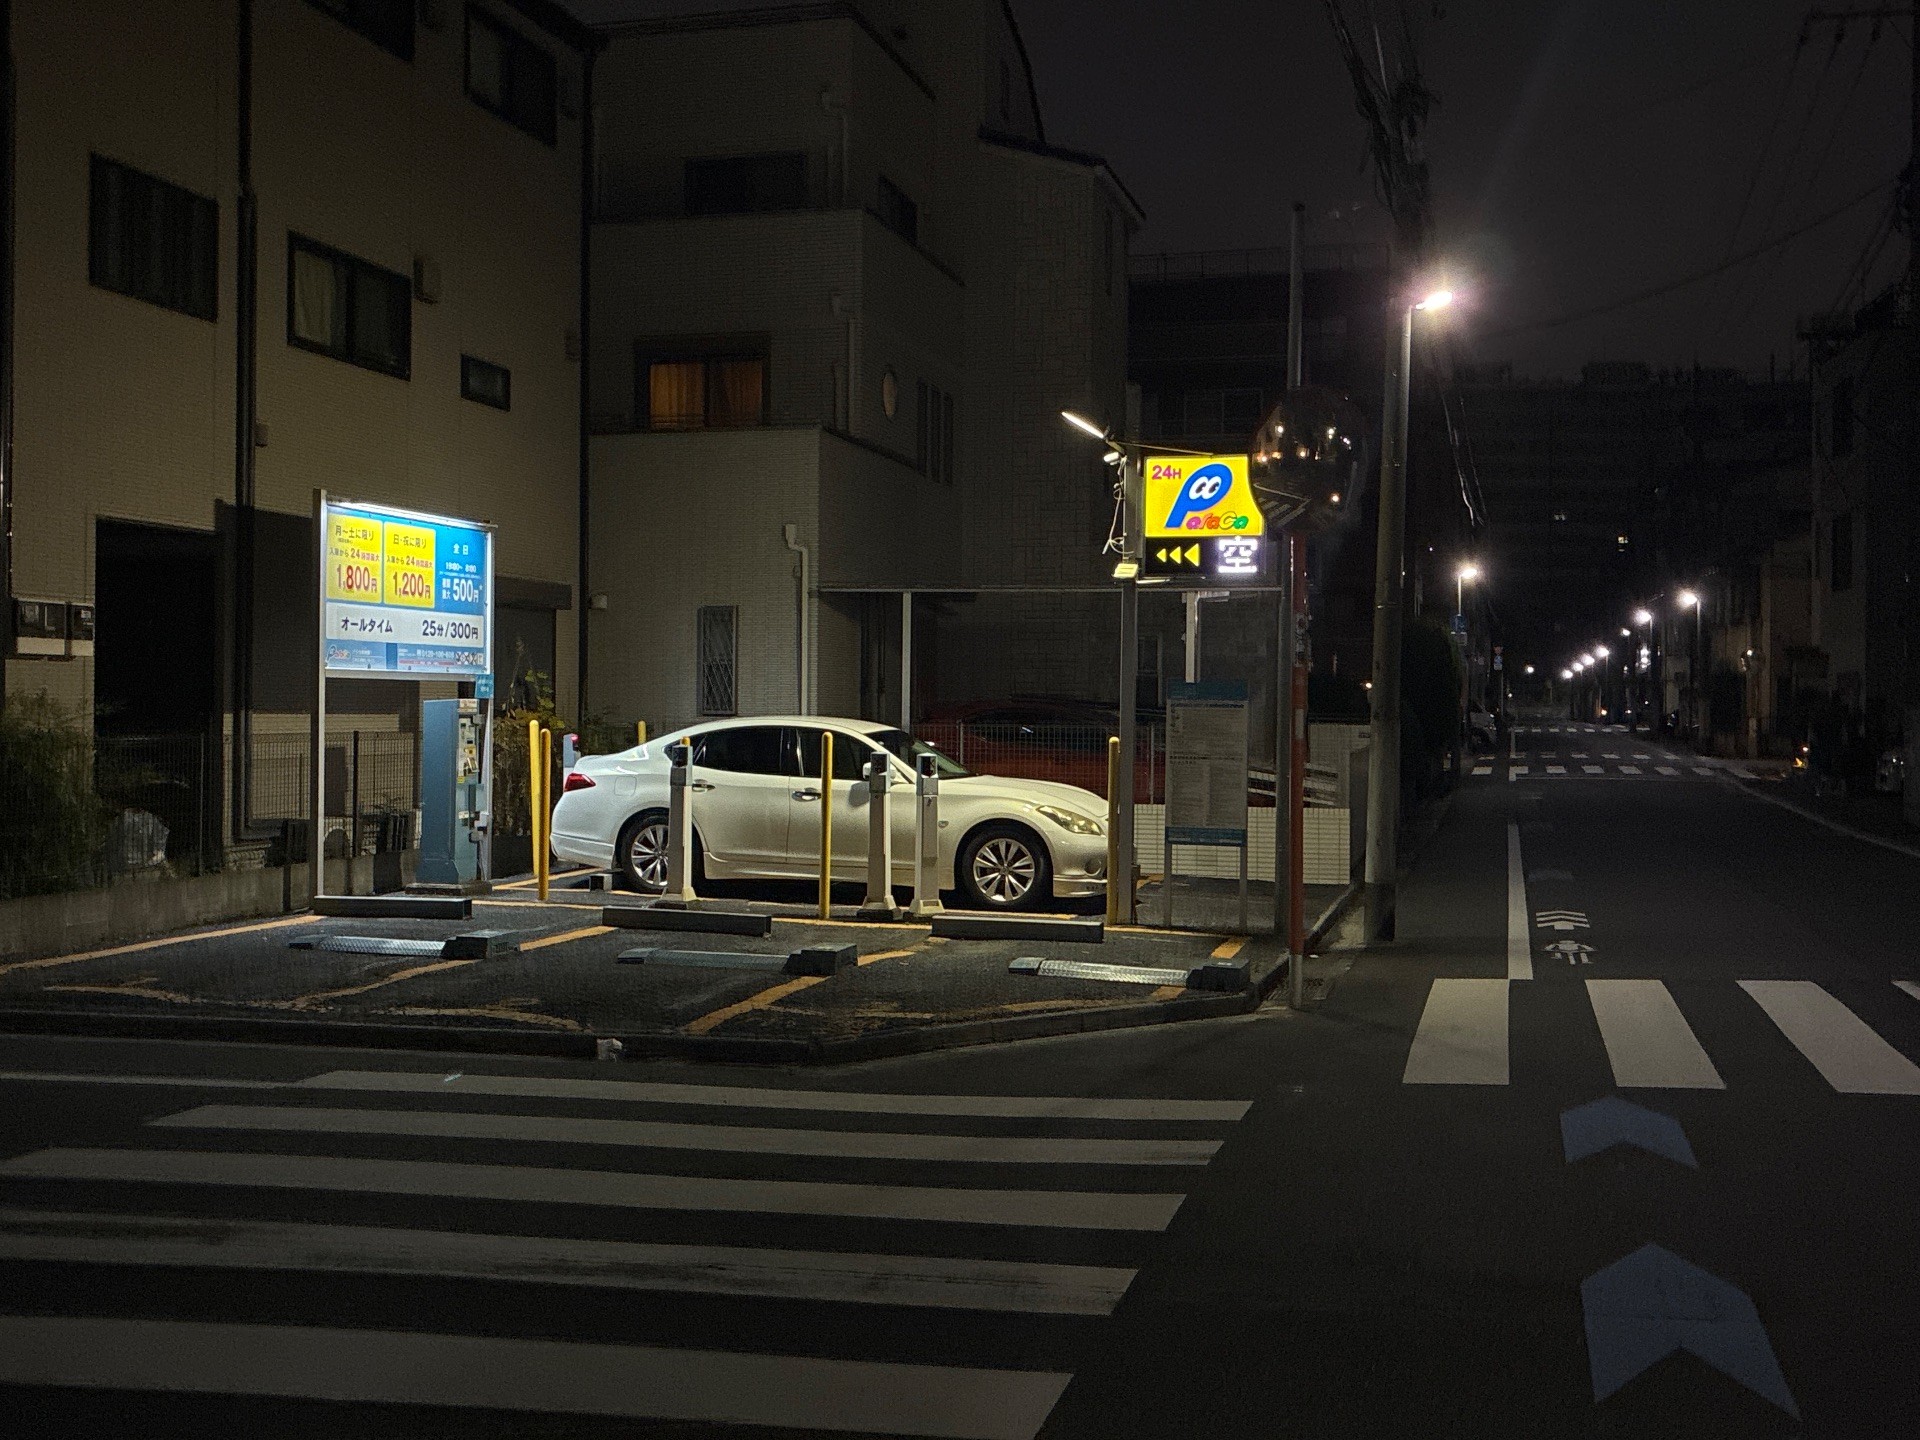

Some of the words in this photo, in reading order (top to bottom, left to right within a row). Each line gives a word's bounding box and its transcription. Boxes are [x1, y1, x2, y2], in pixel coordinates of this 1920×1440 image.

[1151, 465, 1182, 481] 24H
[1217, 535, 1259, 574] 空
[336, 563, 378, 593] 1,800円
[393, 571, 431, 599] 1,200円
[453, 577, 479, 603] 500円
[340, 617, 394, 633] オールタイム
[422, 619, 479, 640] 25分/300円
